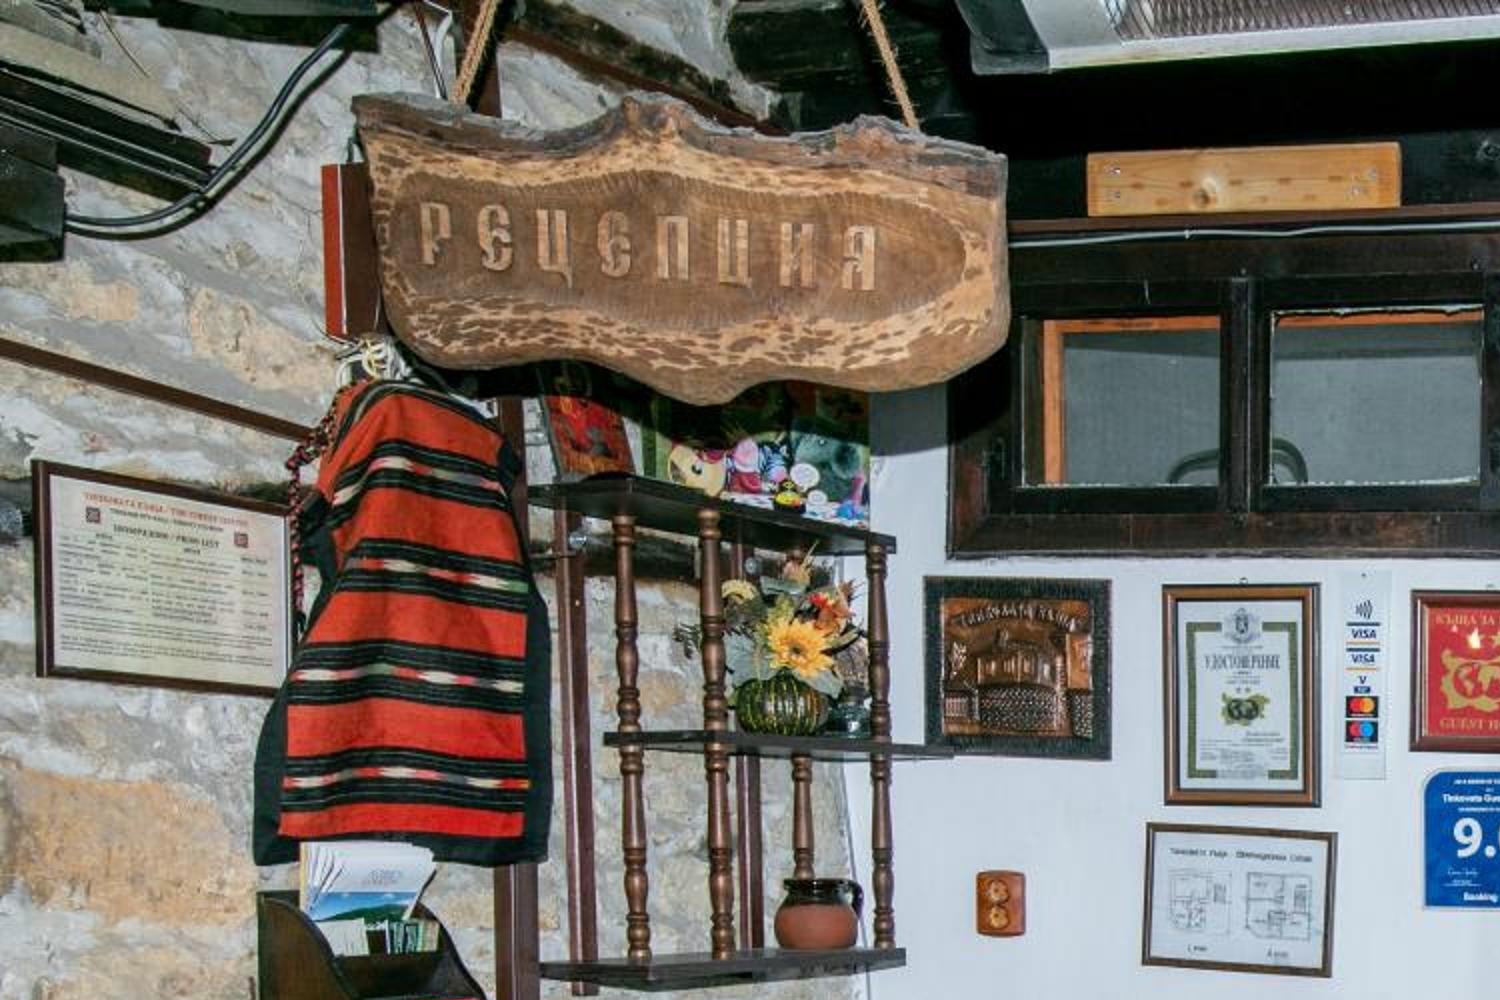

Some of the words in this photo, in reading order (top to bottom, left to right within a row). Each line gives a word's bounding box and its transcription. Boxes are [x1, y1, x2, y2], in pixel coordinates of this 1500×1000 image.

[419, 201, 878, 291] РЕЦЕПЦИЯ
[1351, 628, 1377, 639] VISA
[1351, 653, 1375, 663] VISA
[1440, 718, 1483, 729] GUEST
